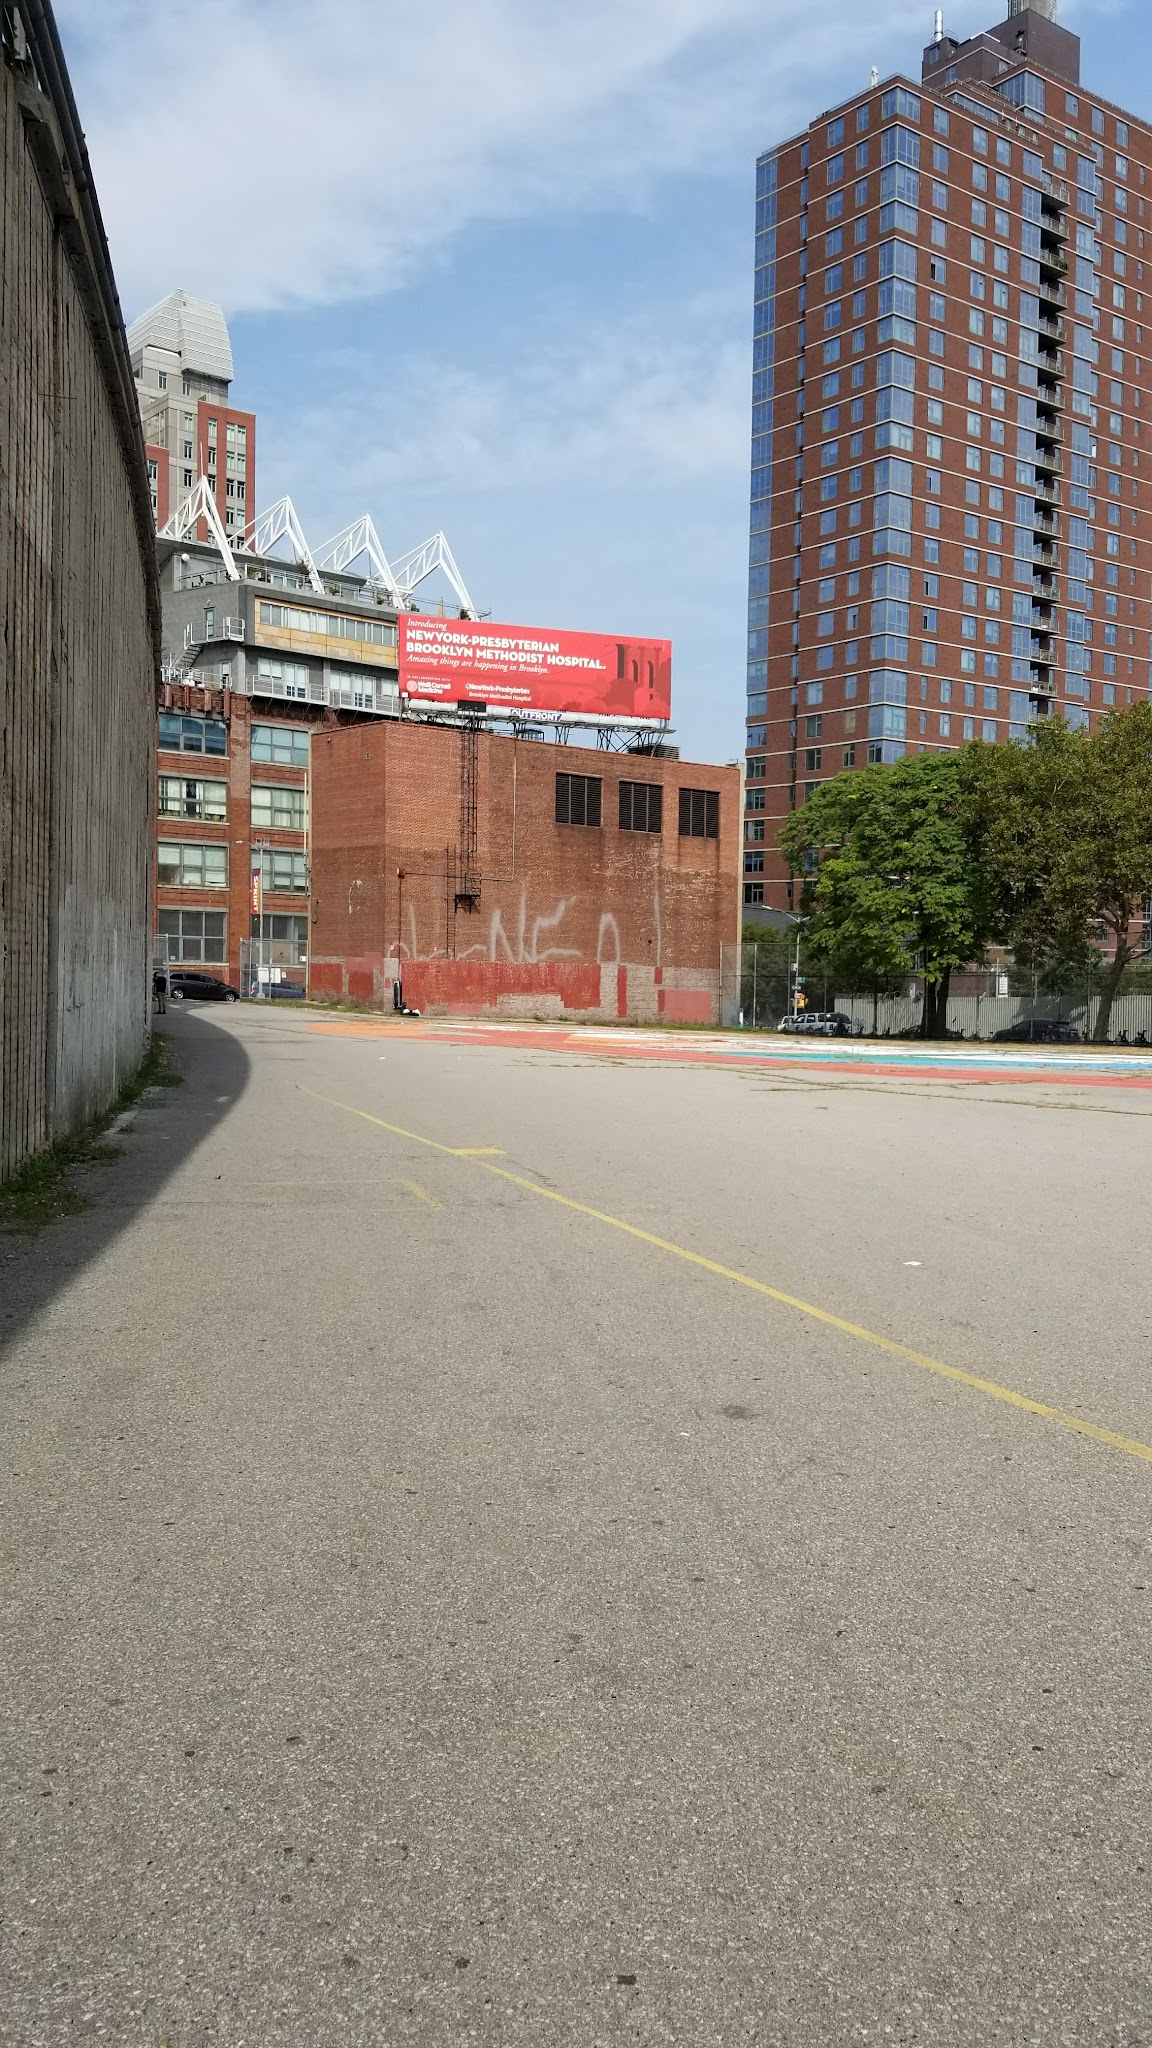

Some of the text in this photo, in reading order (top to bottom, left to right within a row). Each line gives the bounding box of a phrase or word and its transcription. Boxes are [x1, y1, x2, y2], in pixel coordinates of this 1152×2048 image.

[406, 618, 448, 632] Introducing
[406, 629, 560, 653] NEWYORK-PRESBYTERIAN
[406, 641, 607, 670] BROOKLYN METHODIST HOSPITAL.
[406, 653, 439, 666] Amazing
[439, 656, 461, 668] things
[473, 659, 509, 672] happening
[509, 662, 518, 671] in
[518, 663, 550, 675] Brooklyn.
[468, 683, 531, 695] NewYork-Presbyterian
[468, 691, 489, 699] Brooklyn
[511, 708, 561, 721] OUTFRONT
